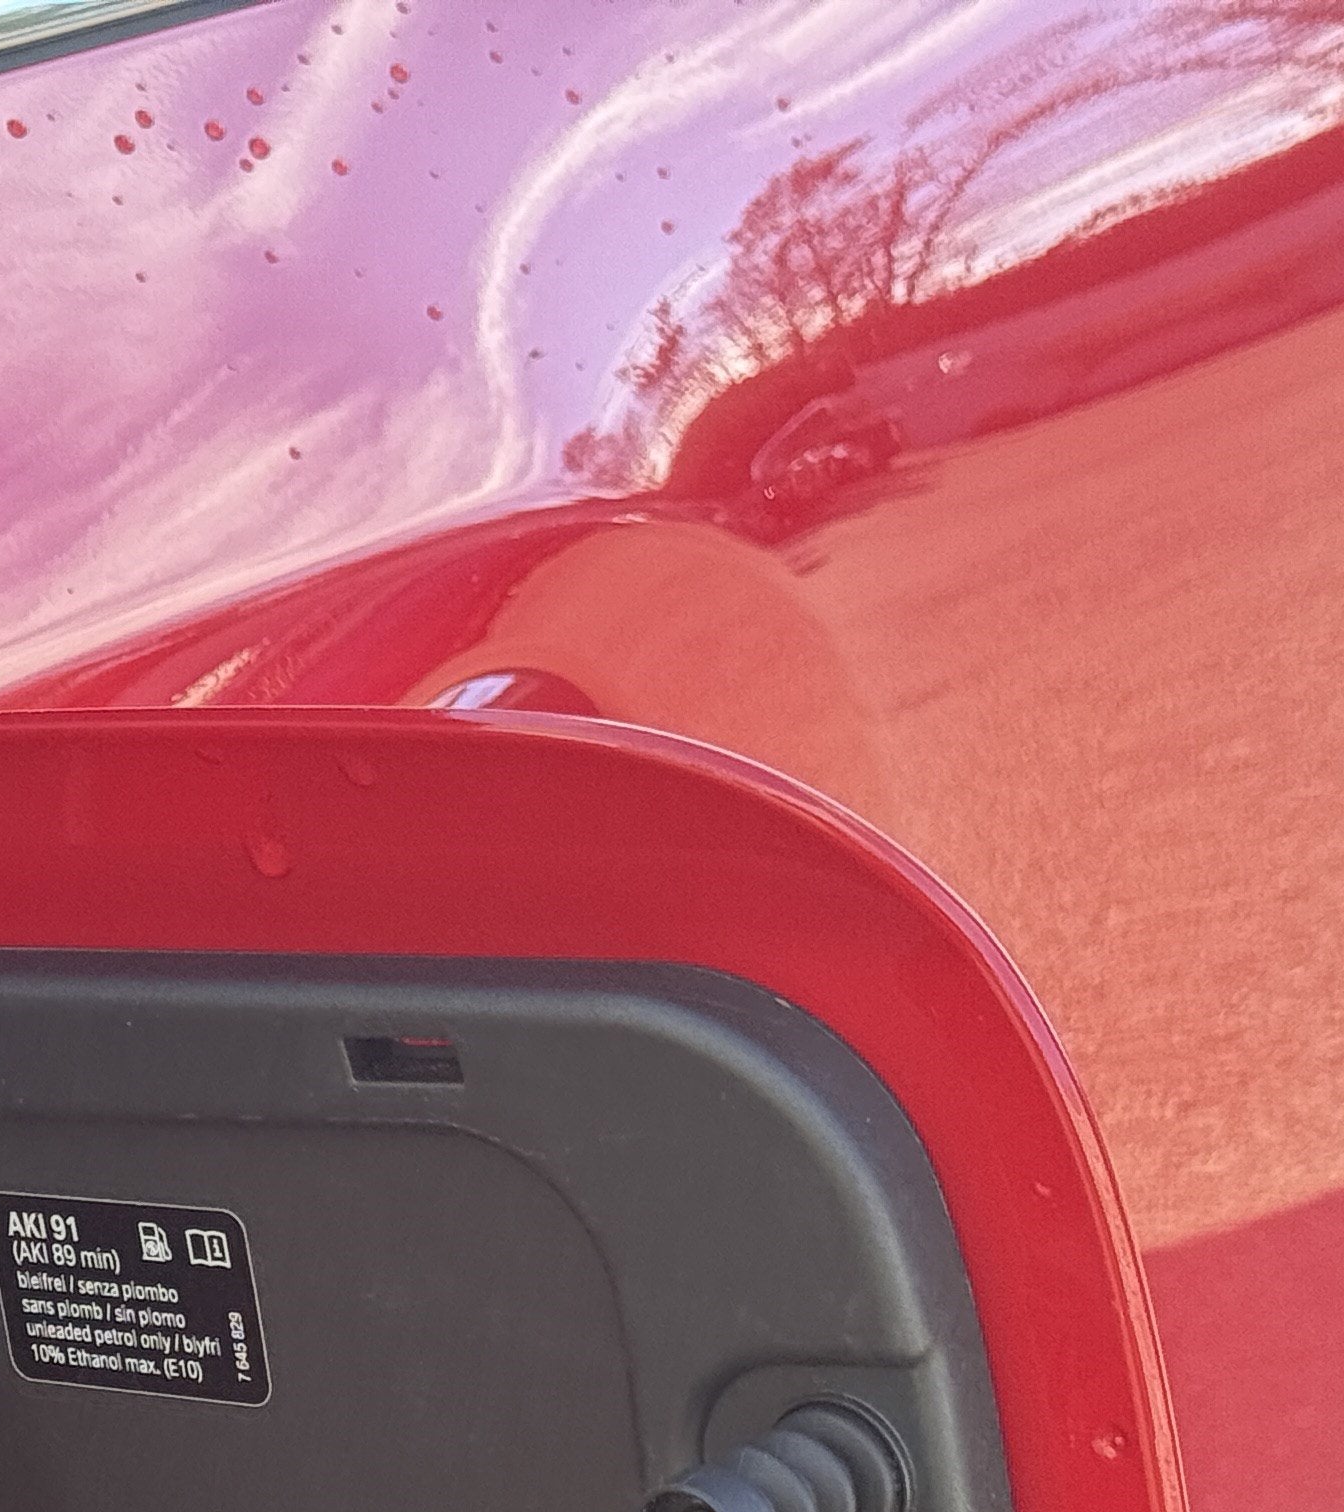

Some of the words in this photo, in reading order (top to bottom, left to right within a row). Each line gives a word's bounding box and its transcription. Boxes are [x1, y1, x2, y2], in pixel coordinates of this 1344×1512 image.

[8, 1211, 47, 1240] AKI
[50, 1214, 80, 1242] 91
[12, 1240, 50, 1266] (AKI
[52, 1244, 77, 1267] 89
[80, 1247, 120, 1275] min)
[77, 1279, 119, 1298] senza
[122, 1281, 179, 1304] plombo
[22, 1298, 55, 1316] sans
[57, 1299, 103, 1320] plomb
[114, 1304, 136, 1324] sin
[138, 1308, 186, 1329] plomo
[26, 1320, 92, 1343] unleaded
[94, 1327, 137, 1349] petrol
[141, 1331, 171, 1354] only
[183, 1334, 222, 1358] blyfri
[30, 1343, 65, 1365] 10%
[67, 1347, 123, 1372] Ethanol
[125, 1355, 161, 1376] max.
[164, 1357, 203, 1383] (E10)
[232, 1342, 250, 1370] 645
[237, 1372, 252, 1382] 7
